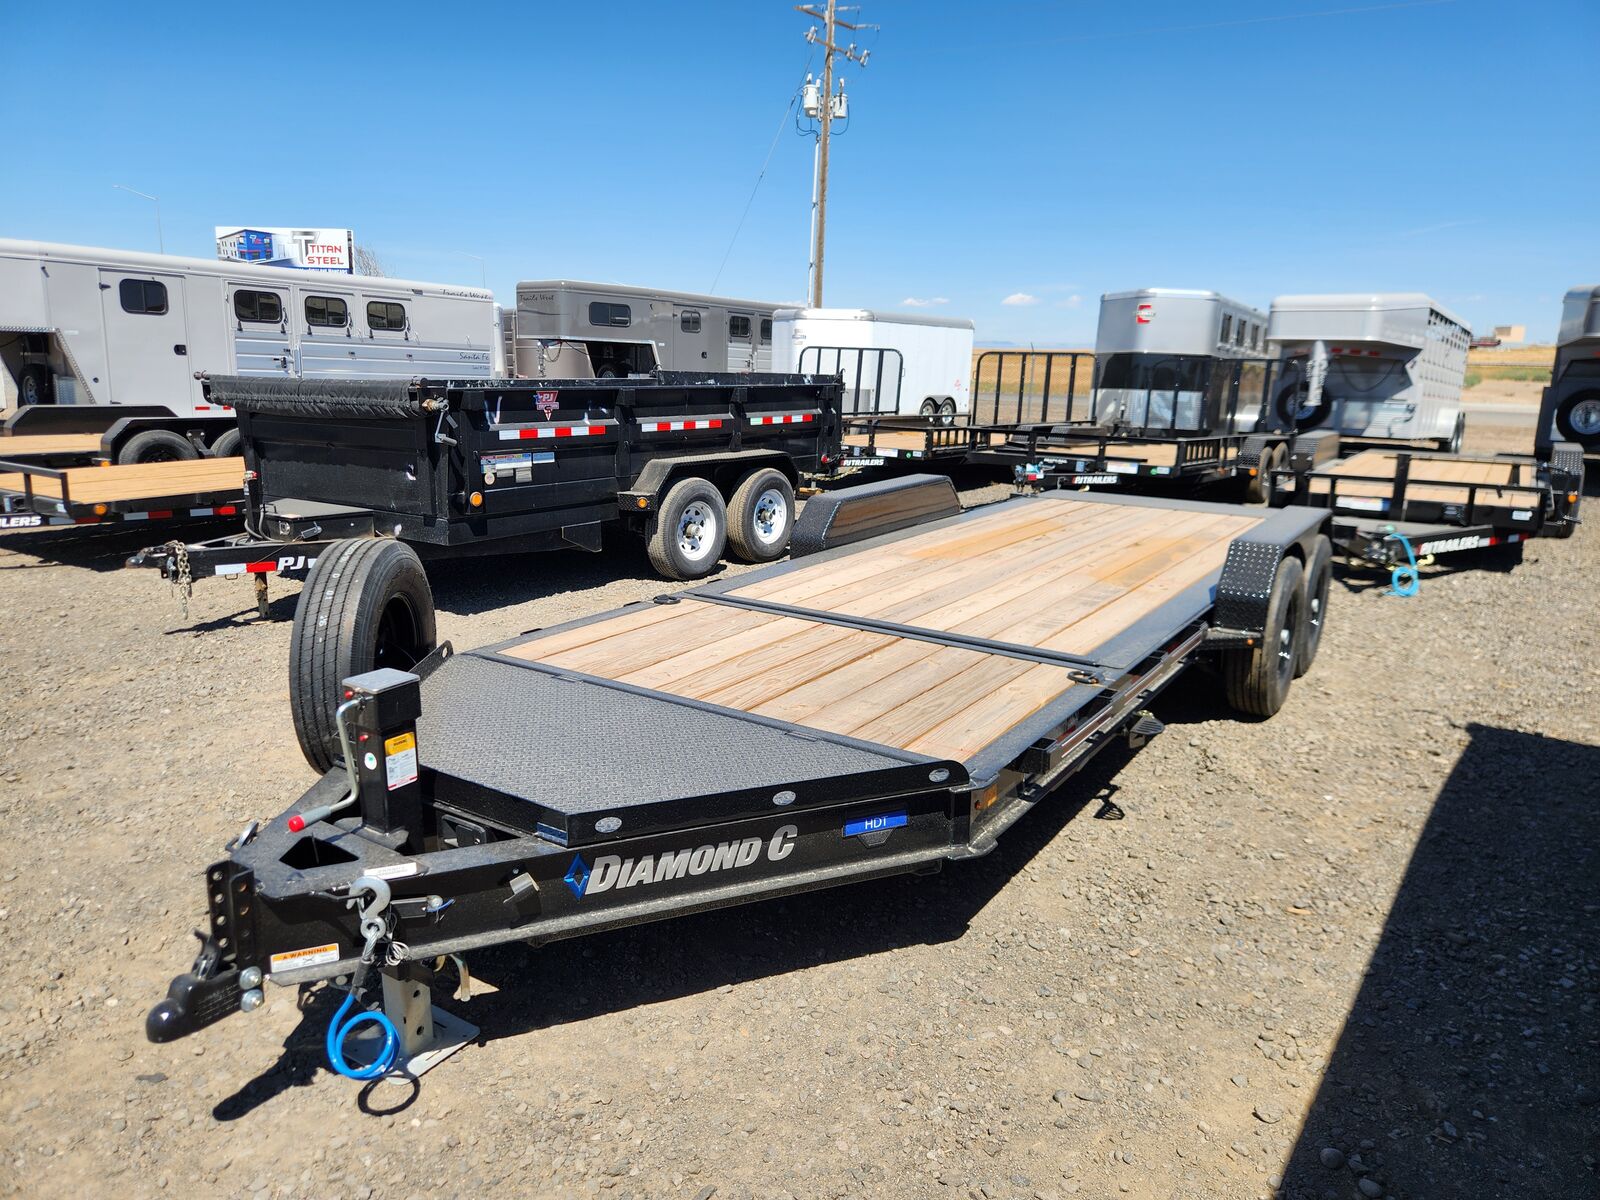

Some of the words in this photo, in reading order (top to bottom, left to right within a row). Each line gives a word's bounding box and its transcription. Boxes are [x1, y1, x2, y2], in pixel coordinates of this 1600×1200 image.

[310, 245, 341, 253] TITAN
[307, 256, 343, 264] STEEL
[459, 351, 480, 360] Santa
[482, 353, 489, 361] Fe
[542, 393, 553, 402] PJ
[277, 556, 305, 571] PJ
[864, 815, 888, 829] HDT
[584, 836, 763, 895] DIAMOND
[766, 824, 799, 862] C
[289, 947, 328, 959] WARNING
